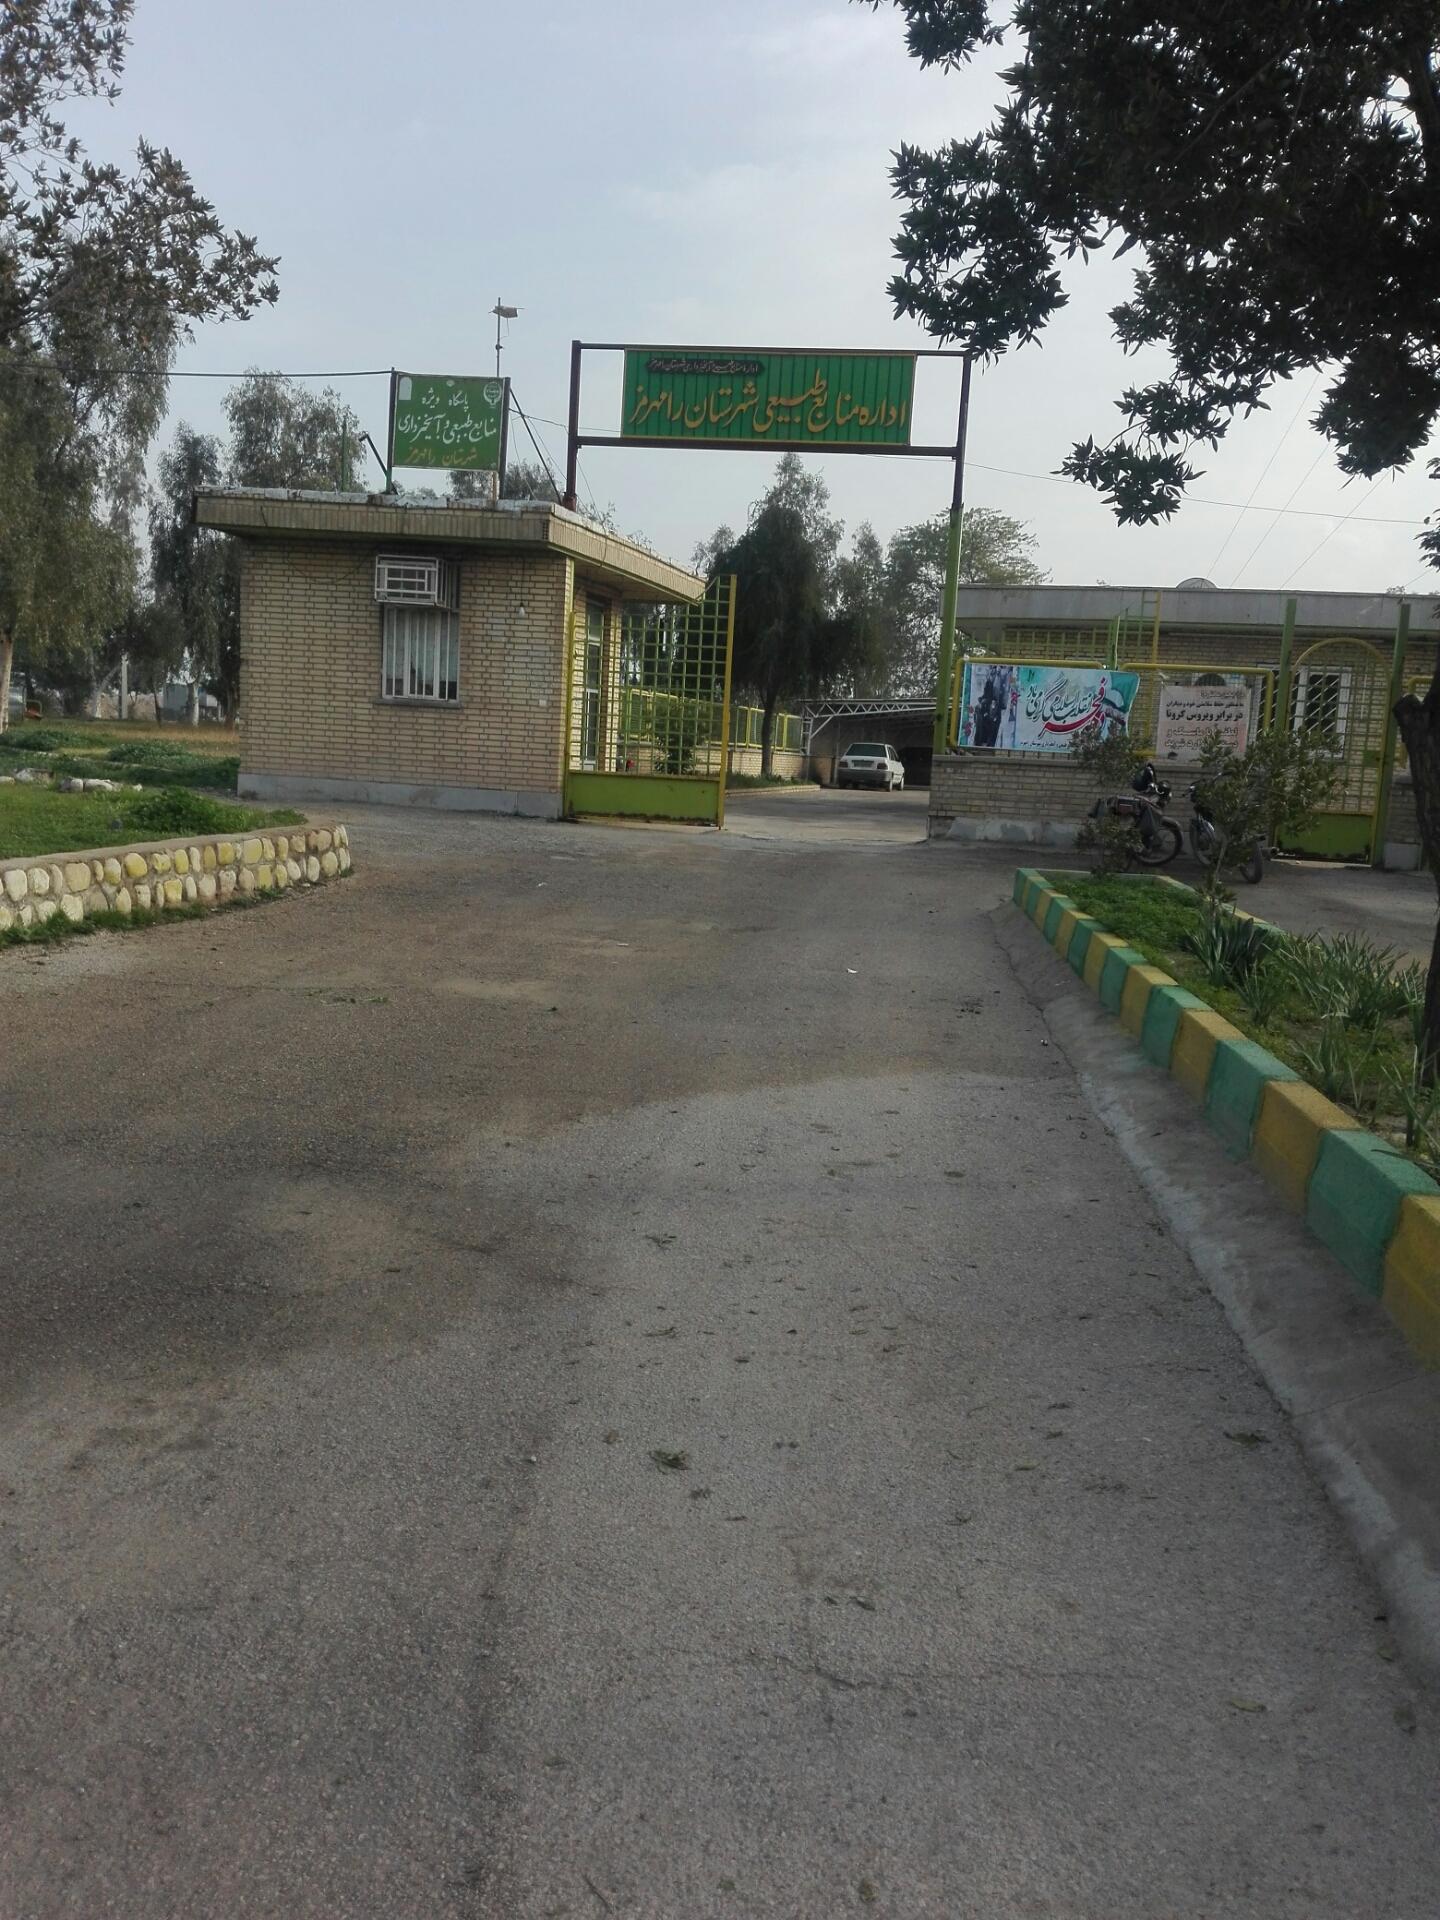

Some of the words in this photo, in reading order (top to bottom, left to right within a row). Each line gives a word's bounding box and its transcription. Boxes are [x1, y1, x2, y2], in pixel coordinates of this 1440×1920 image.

[421, 387, 440, 408] ویژه
[448, 390, 468, 412] پاسگاه
[628, 386, 685, 424] رامهرمز
[683, 381, 760, 429] شهرستان
[752, 369, 826, 433] طبیعی
[805, 391, 860, 433] منابع
[859, 397, 907, 429] اداره
[398, 413, 446, 443] آبخیزداری
[443, 419, 450, 430] و
[443, 414, 473, 444] طبیعی
[468, 418, 497, 442] منابع
[441, 447, 477, 465] شهرستان
[1038, 677, 1106, 738] فجر
[1166, 709, 1186, 721] کرونا
[1186, 711, 1214, 722] ویروس
[1214, 710, 1233, 722] برابر
[1233, 712, 1243, 721] در
